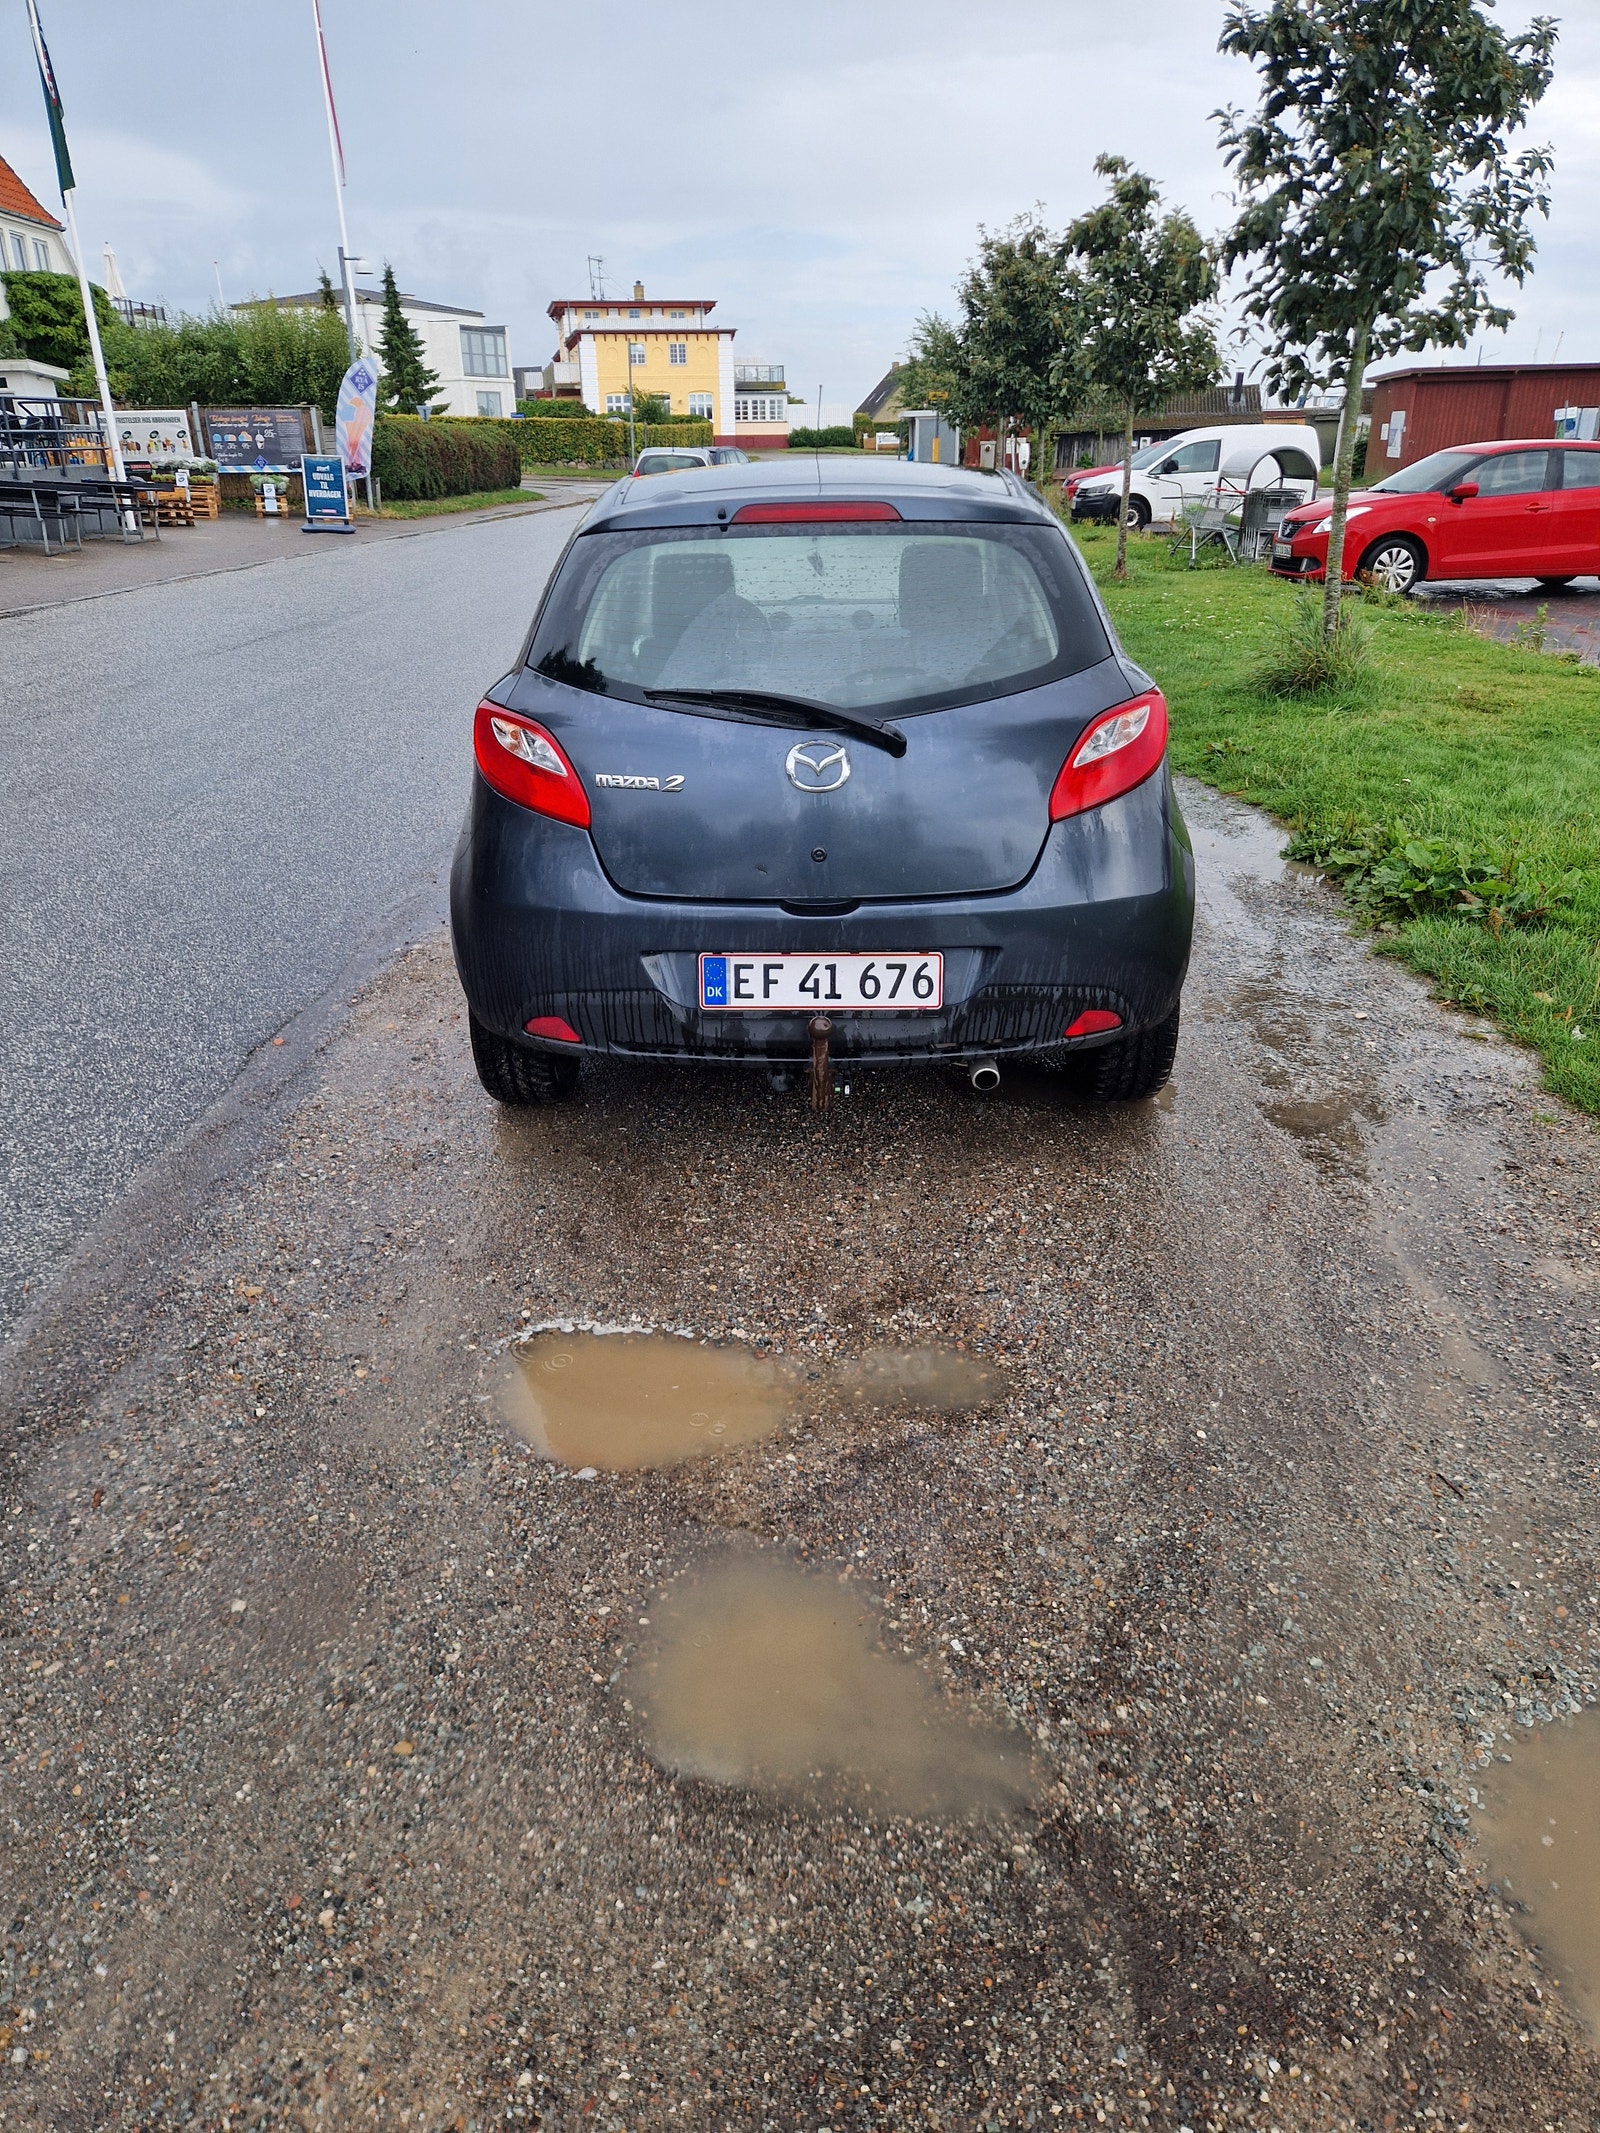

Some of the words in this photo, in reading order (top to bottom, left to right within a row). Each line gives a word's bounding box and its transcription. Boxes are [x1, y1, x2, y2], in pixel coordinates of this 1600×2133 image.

[312, 473, 334, 481] UDVALG
[308, 490, 341, 499] HVERDAGEN
[733, 963, 784, 999] EF
[798, 963, 842, 1000] 41
[859, 962, 934, 1000] 676
[707, 986, 723, 998] DK
